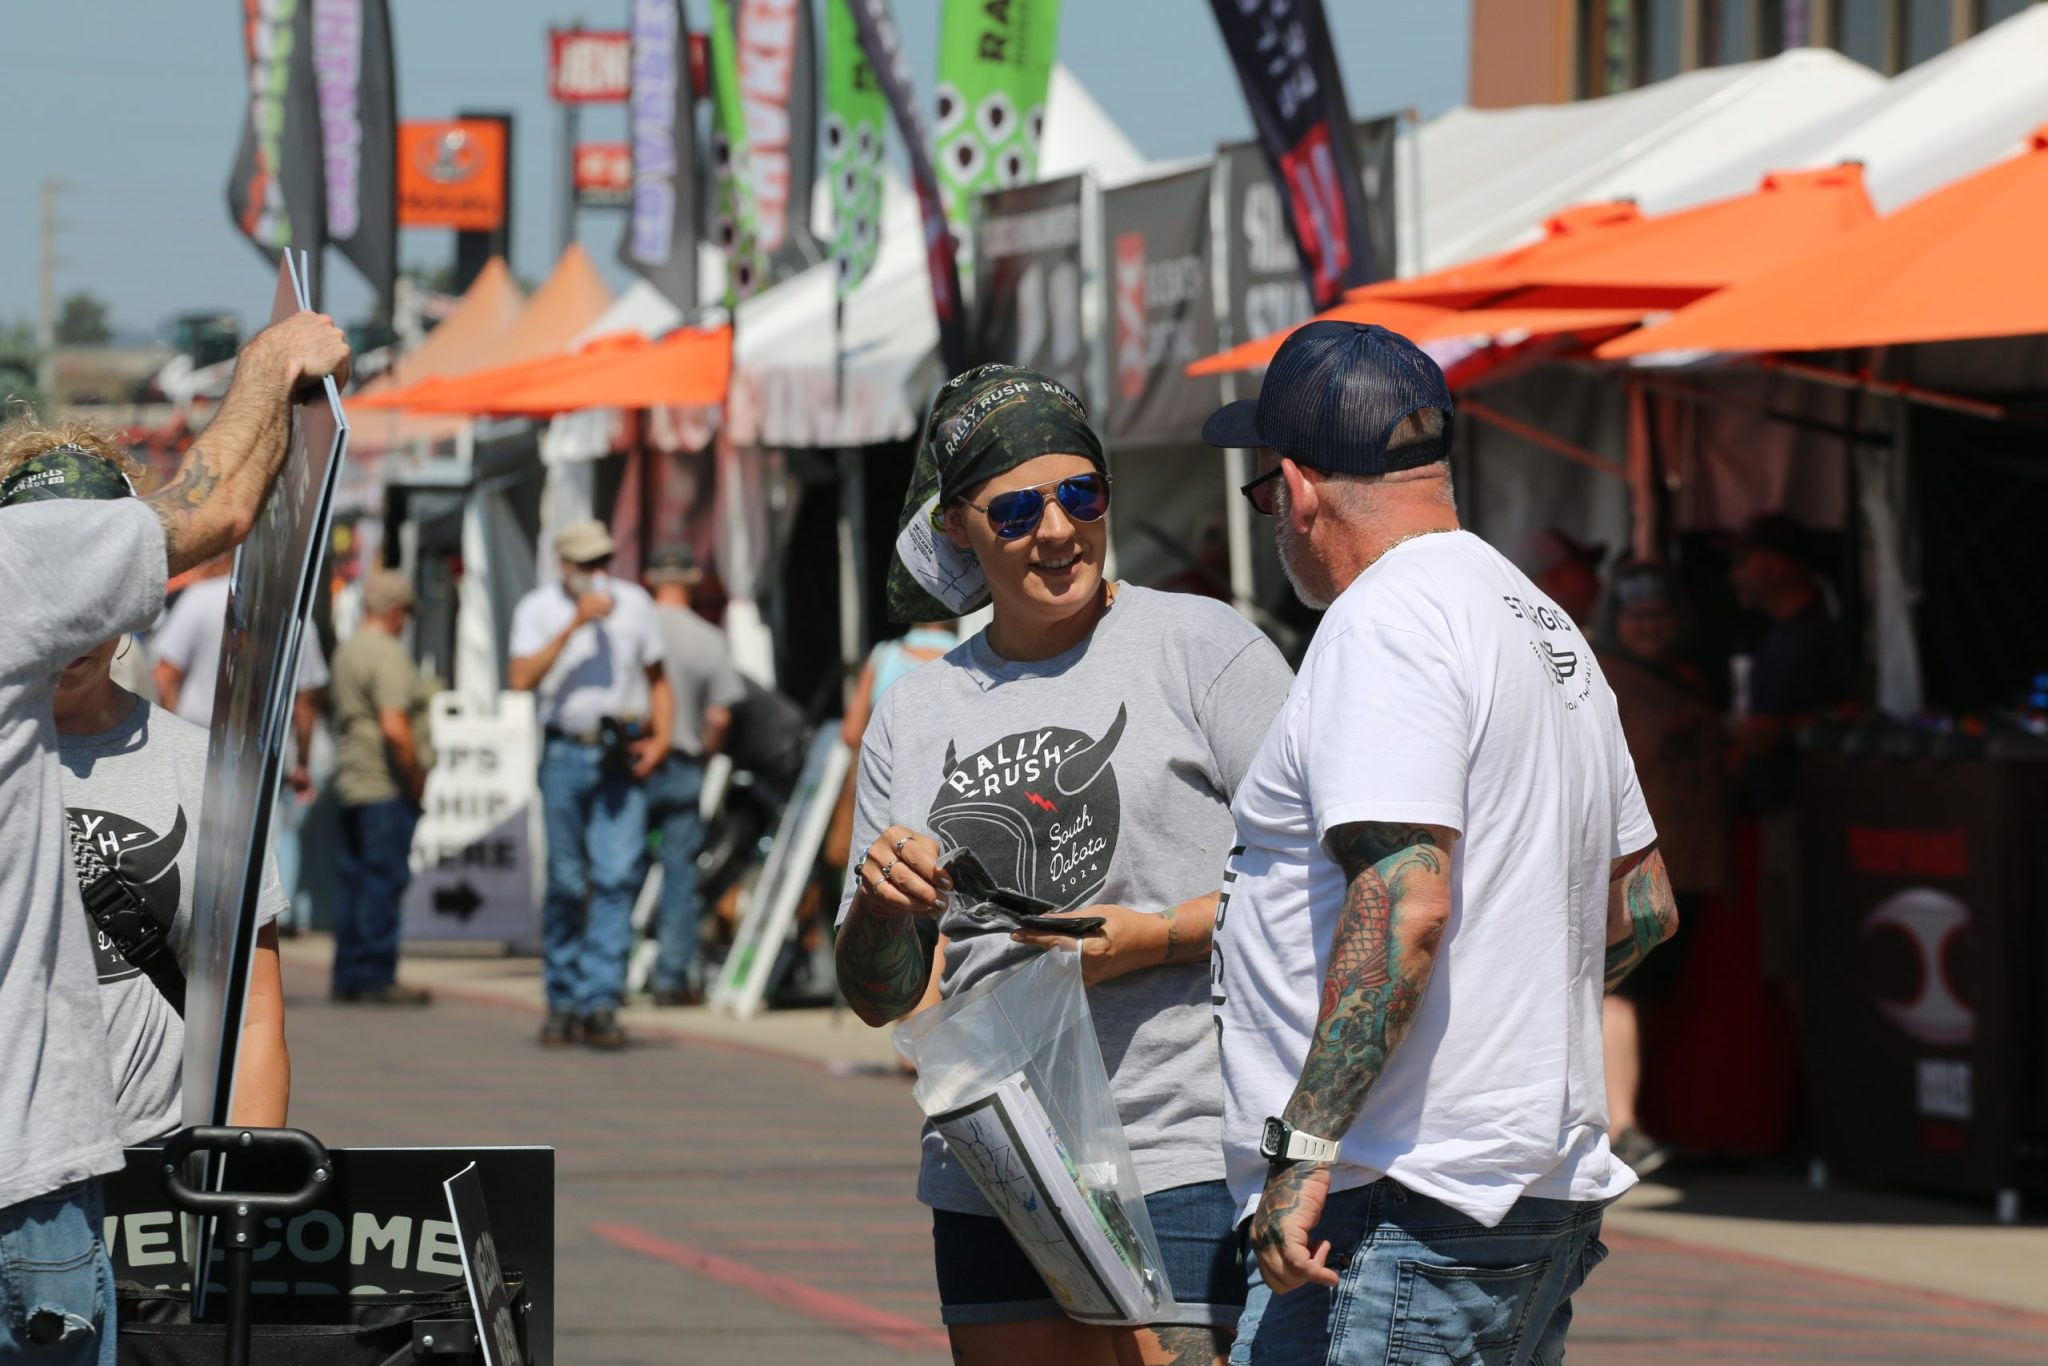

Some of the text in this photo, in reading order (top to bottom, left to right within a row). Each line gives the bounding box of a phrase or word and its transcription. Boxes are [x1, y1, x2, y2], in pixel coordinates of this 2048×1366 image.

[945, 382, 1029, 457] RALLY RUSH
[949, 731, 1053, 794] RALLY
[984, 746, 1061, 797] RUSH
[1050, 804, 1094, 851] South
[1050, 837, 1108, 882] Dakota
[1061, 862, 1098, 893] 2024
